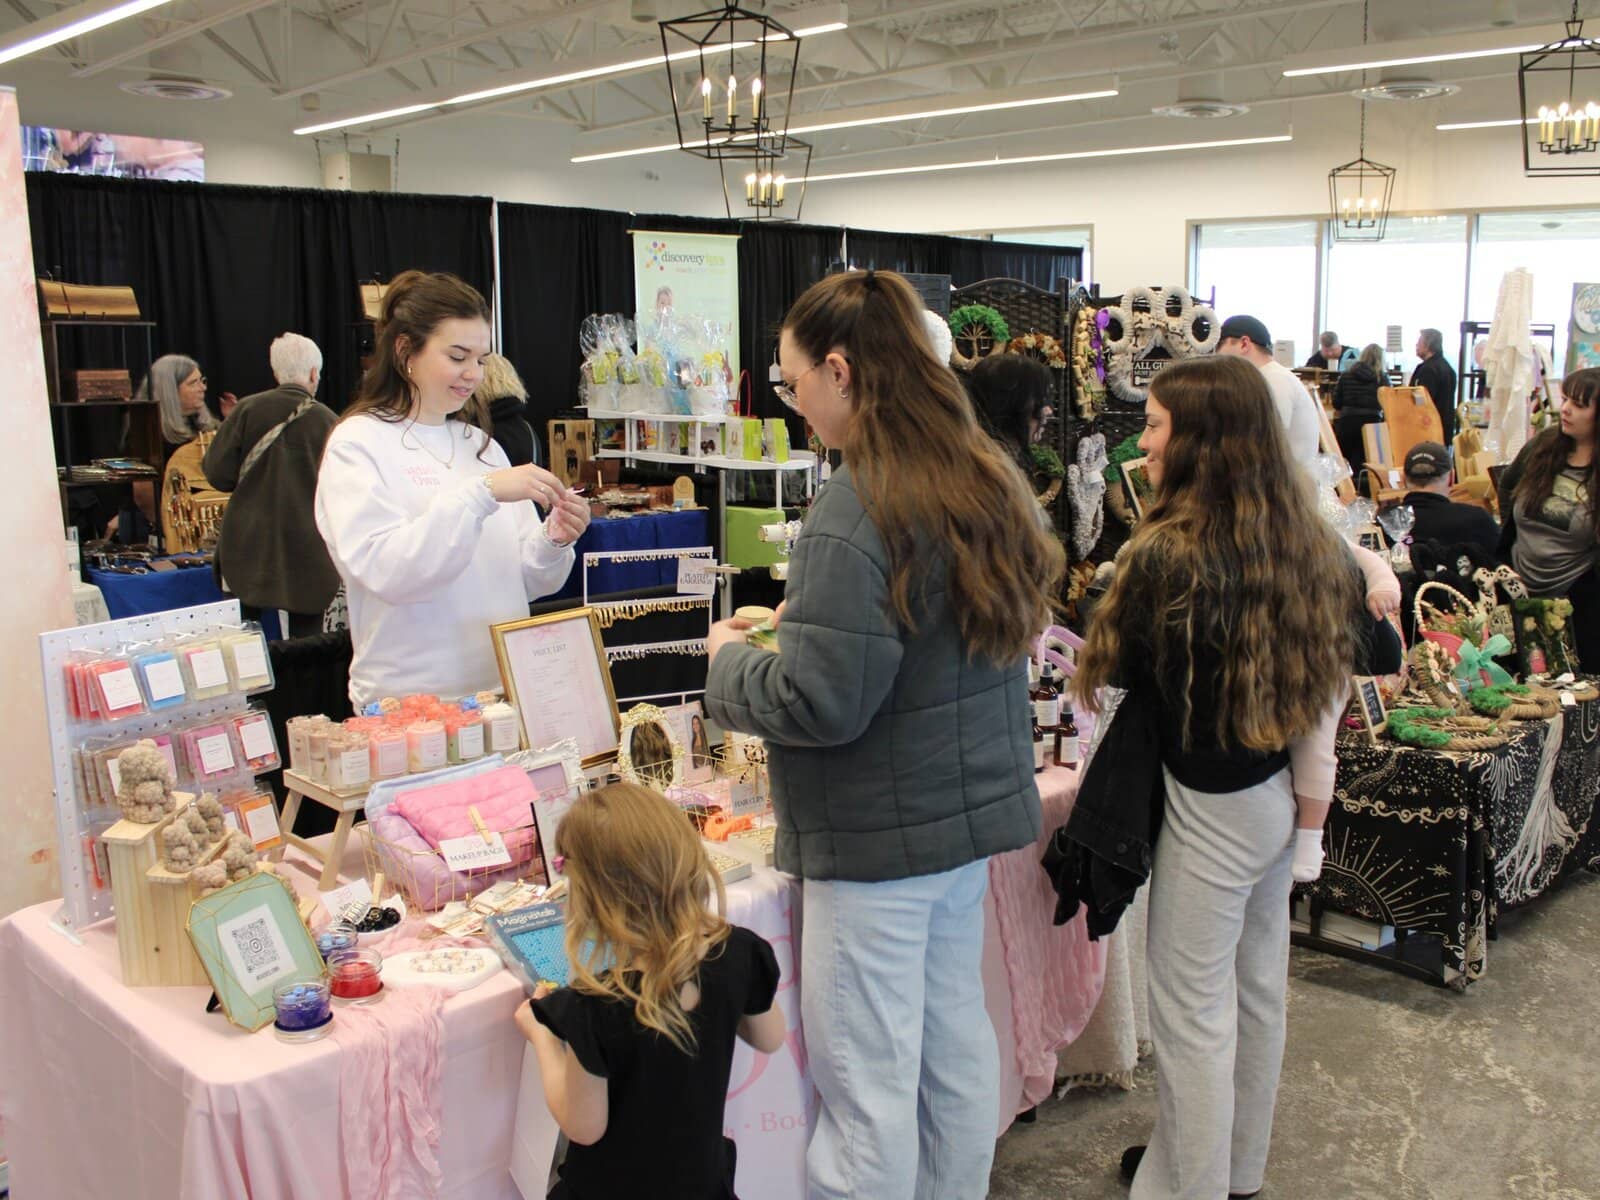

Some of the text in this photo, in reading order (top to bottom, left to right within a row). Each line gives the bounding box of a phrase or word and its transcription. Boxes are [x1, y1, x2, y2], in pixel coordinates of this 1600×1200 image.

[661, 251, 705, 266] discovery
[1134, 361, 1151, 371] ALL
[449, 851, 483, 862] MAKEUP
